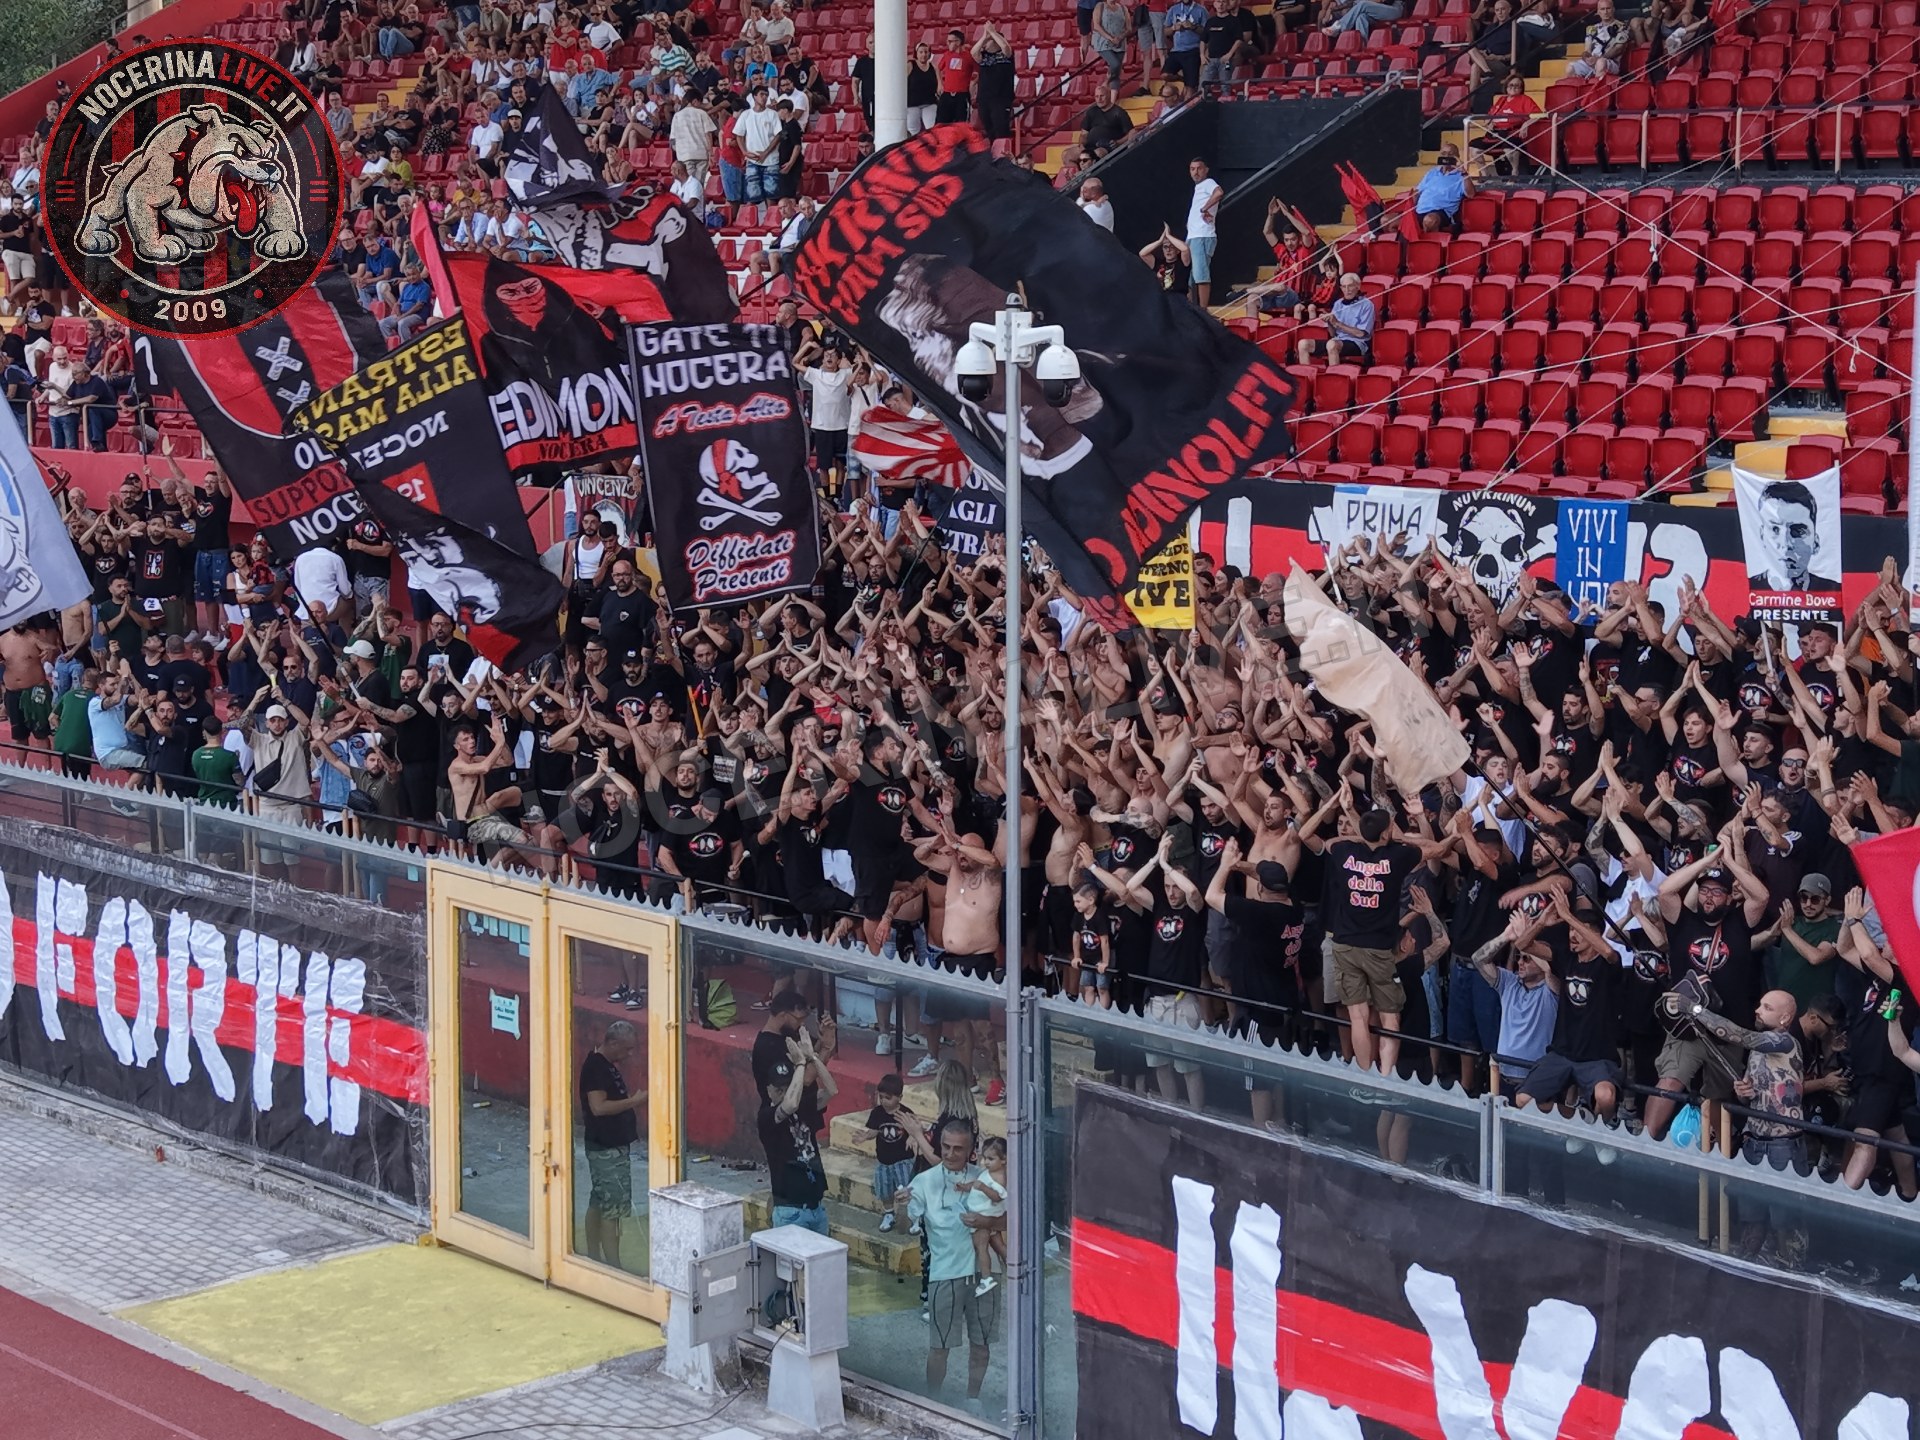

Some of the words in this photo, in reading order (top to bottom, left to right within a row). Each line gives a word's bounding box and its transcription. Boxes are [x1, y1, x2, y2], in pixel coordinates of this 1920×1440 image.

[634, 322, 731, 357] GATE
[641, 350, 790, 398] NOCERA
[289, 492, 364, 545] NOCE
[1346, 499, 1422, 536] PRIMA
[1567, 508, 1617, 544] VIVI
[688, 532, 794, 571] Diffidati
[1576, 547, 1602, 578] IN
[696, 559, 789, 599] Presenti
[1749, 592, 1802, 606] Carmine
[1805, 593, 1836, 607] Bove
[1753, 609, 1829, 621] PRESENTE
[1342, 855, 1391, 877] Angeli
[1348, 875, 1385, 892] della
[1350, 892, 1380, 909] Sud
[36, 871, 366, 1136] FORTE
